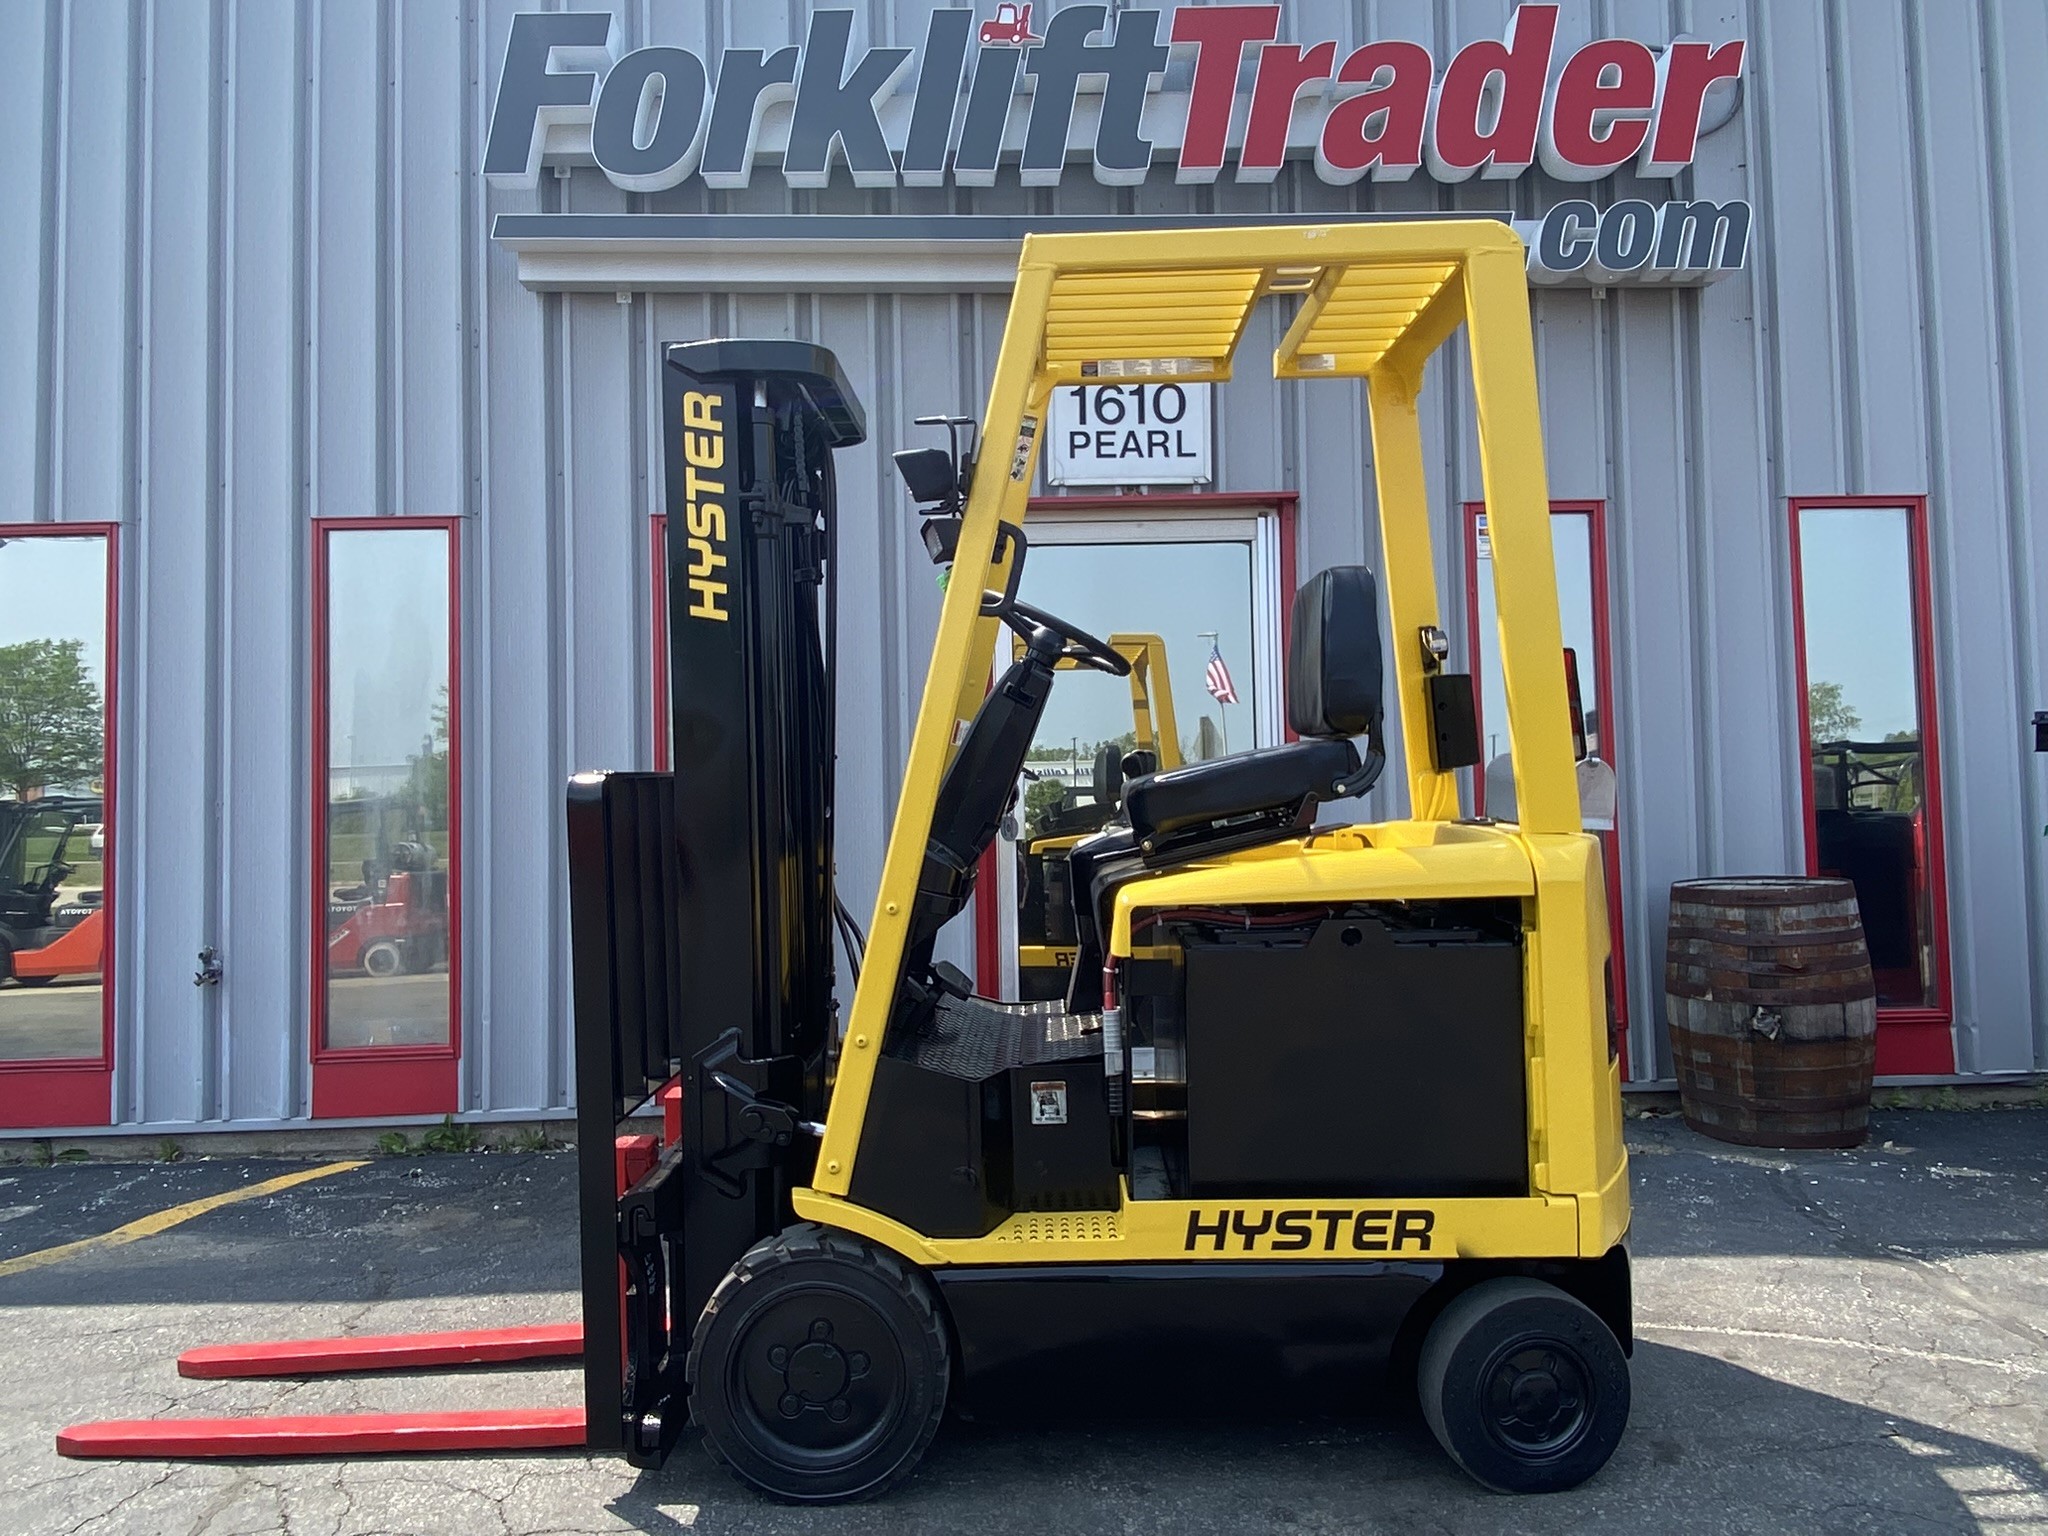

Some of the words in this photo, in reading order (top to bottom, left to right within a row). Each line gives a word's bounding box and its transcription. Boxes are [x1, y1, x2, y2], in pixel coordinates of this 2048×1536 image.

[481, 3, 1747, 186] ForkliftTrader
[1069, 383, 1187, 426] 1610
[1069, 430, 1197, 459] PEARL
[683, 391, 729, 622] HYSTER
[1184, 1210, 1435, 1251] HYSTER
